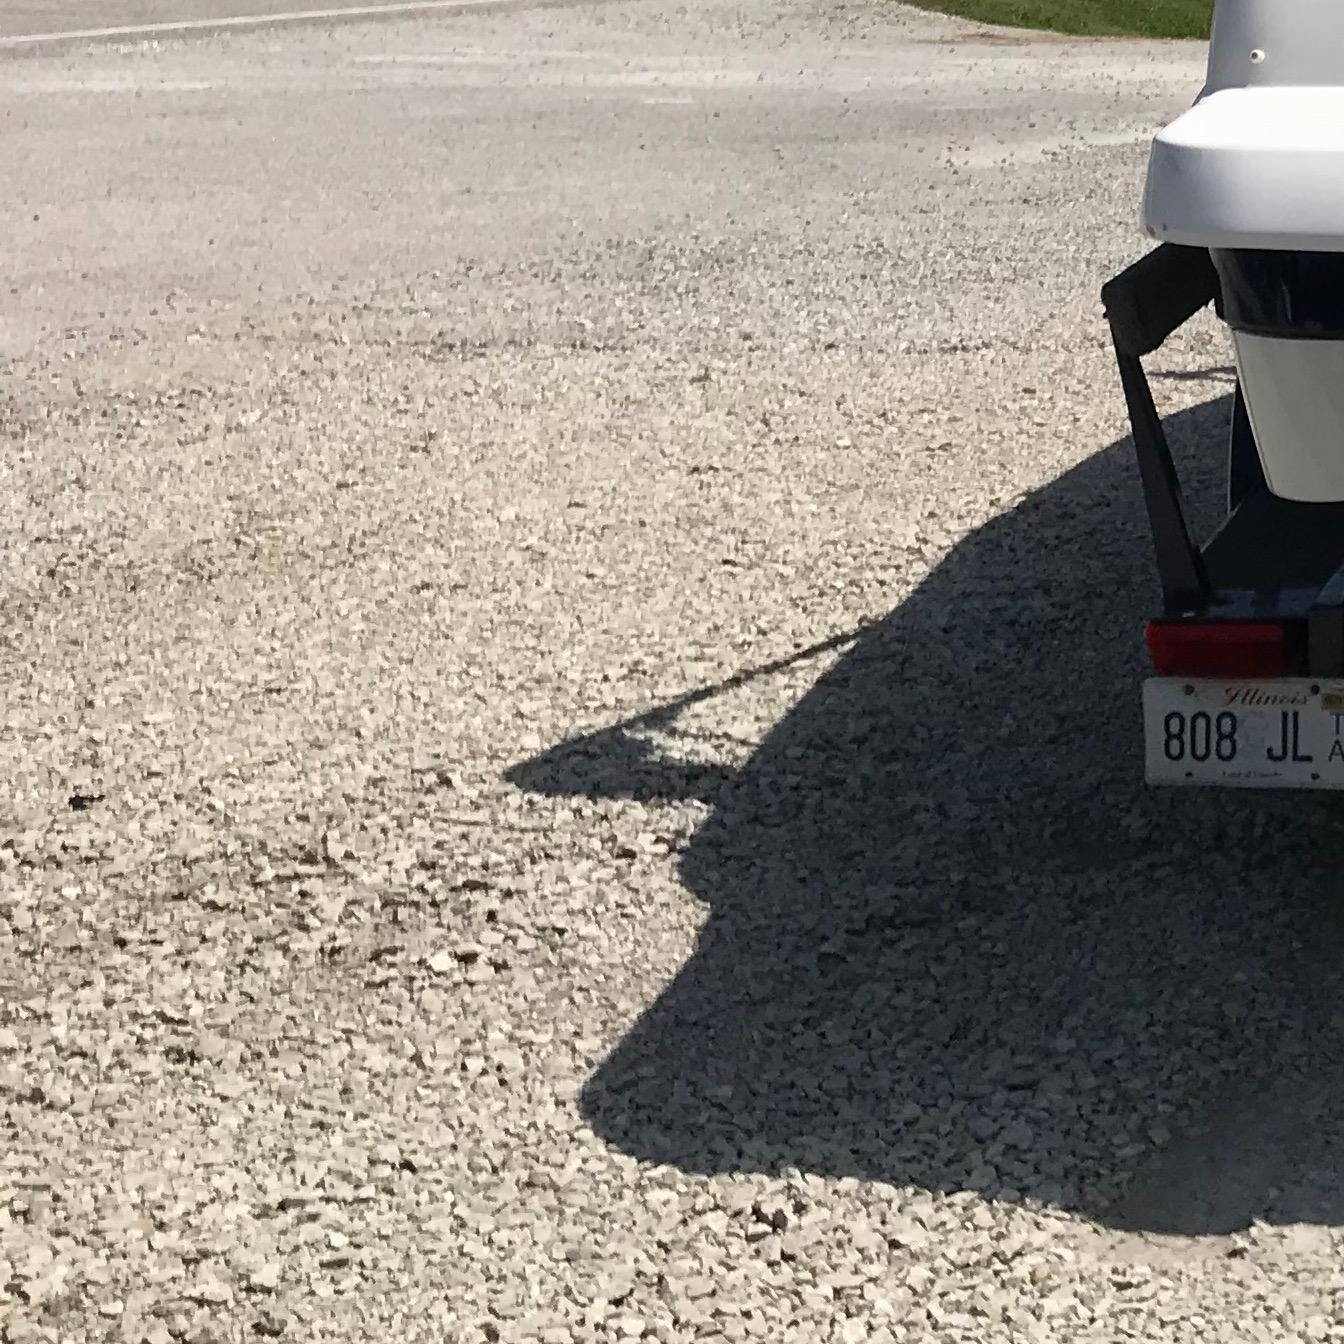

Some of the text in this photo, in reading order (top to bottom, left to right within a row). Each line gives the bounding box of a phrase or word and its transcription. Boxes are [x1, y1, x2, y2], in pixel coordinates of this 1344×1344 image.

[1224, 687, 1310, 706] Illinois
[1163, 710, 1314, 763] 808 JL
